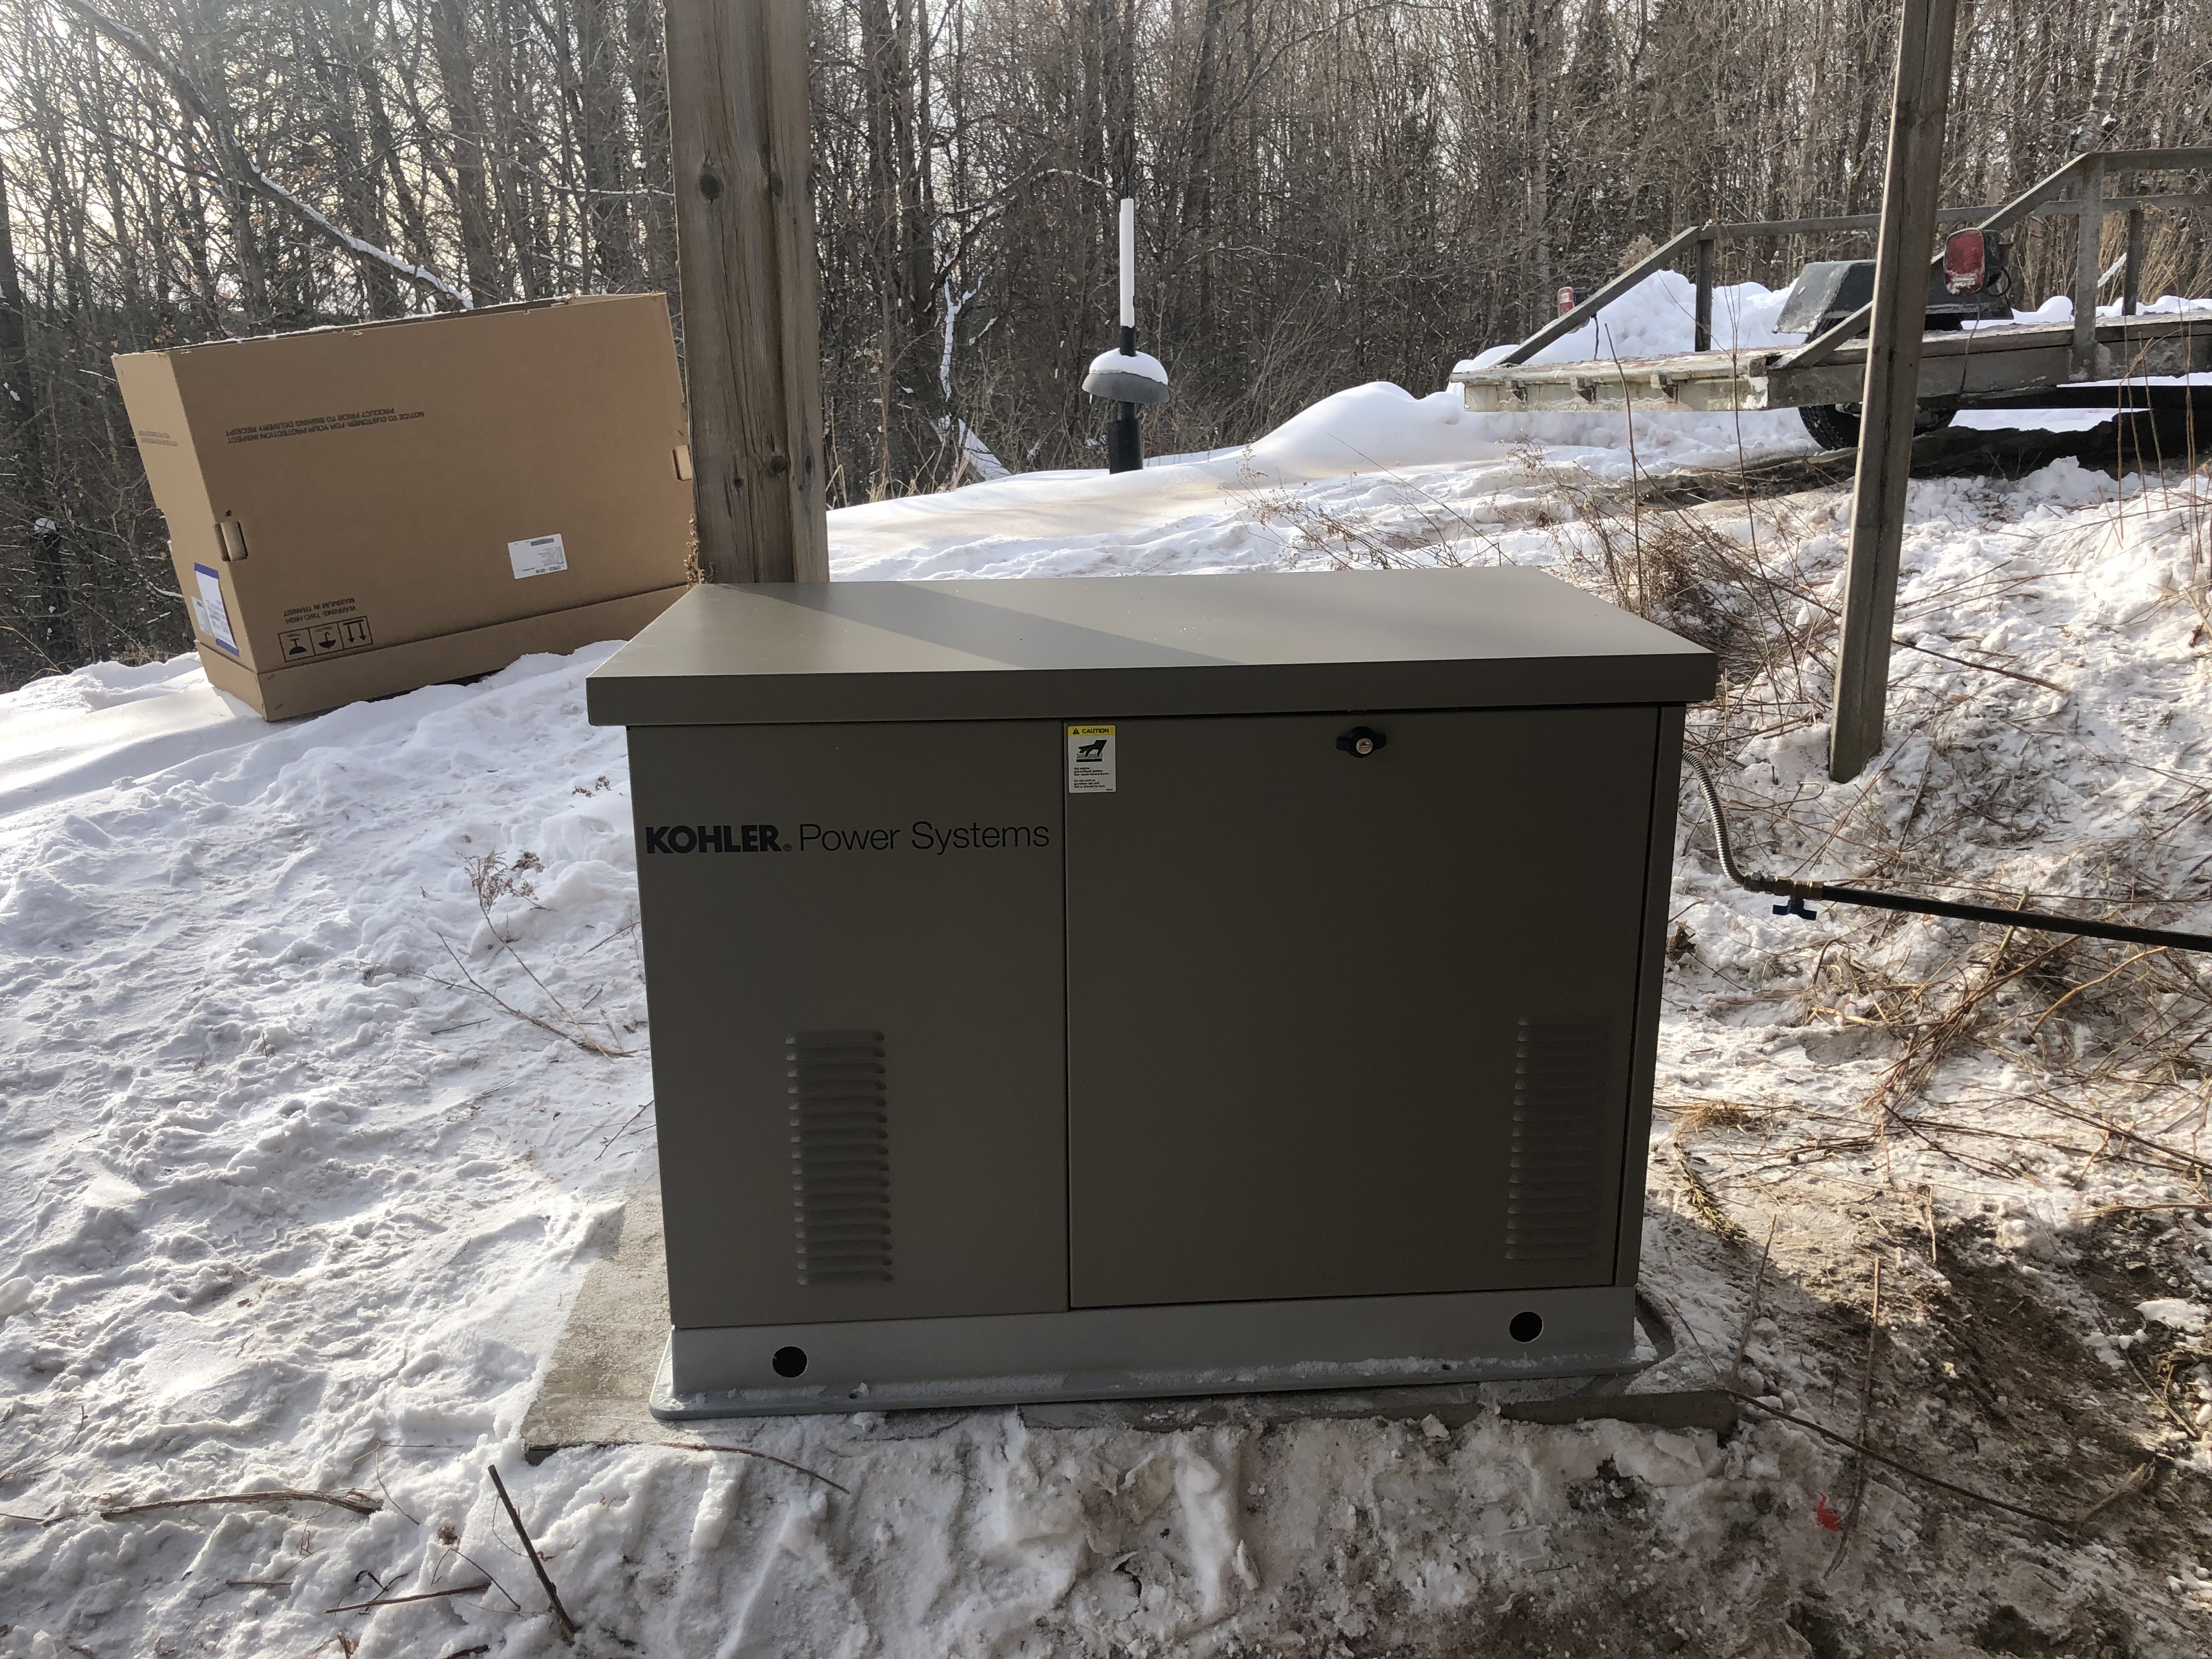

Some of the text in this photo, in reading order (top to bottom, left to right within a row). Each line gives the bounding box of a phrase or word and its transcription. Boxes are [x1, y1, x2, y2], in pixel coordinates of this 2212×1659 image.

[337, 413, 360, 421] PRIOR
[361, 408, 394, 418] PRODUCT
[399, 411, 425, 420] NOTICE
[225, 426, 257, 436] RECEIPT
[259, 421, 294, 431] DELIVERY
[308, 425, 329, 433] YOUR
[260, 428, 307, 439] PROTECTION
[228, 434, 259, 444] INSPECT
[283, 606, 313, 617] TRANSIT
[285, 616, 303, 624] HIGH
[799, 823, 901, 851] Power
[911, 820, 1050, 856] Systems
